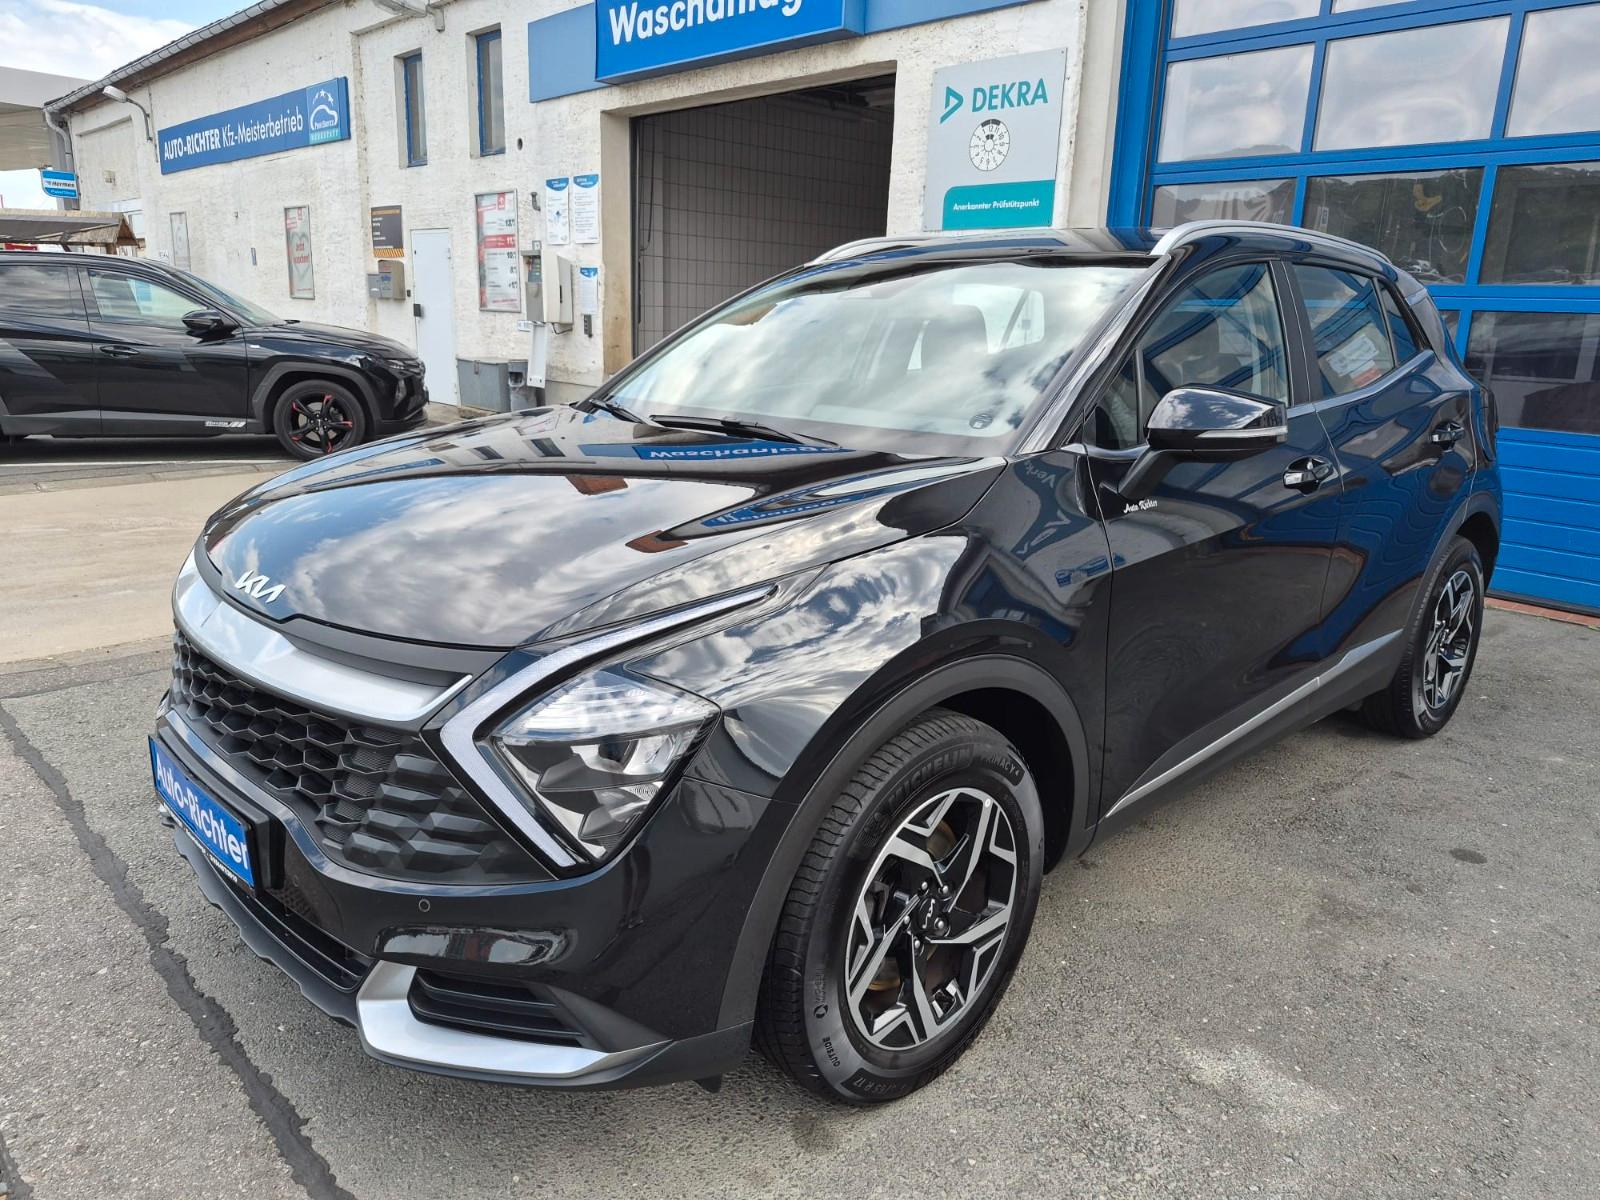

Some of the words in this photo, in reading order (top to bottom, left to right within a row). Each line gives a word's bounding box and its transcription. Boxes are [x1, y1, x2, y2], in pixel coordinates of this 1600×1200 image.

[971, 77, 1048, 113] DEKRA
[164, 129, 221, 161] AUTO-RICHTER
[222, 106, 304, 148] Kfz-Meisterbetrieb
[953, 200, 992, 212] Anerkannter
[992, 198, 1040, 210] Prüfstützpunkt
[156, 753, 249, 870] Auto-Richter
[822, 1036, 841, 1068] OUTSIDE
